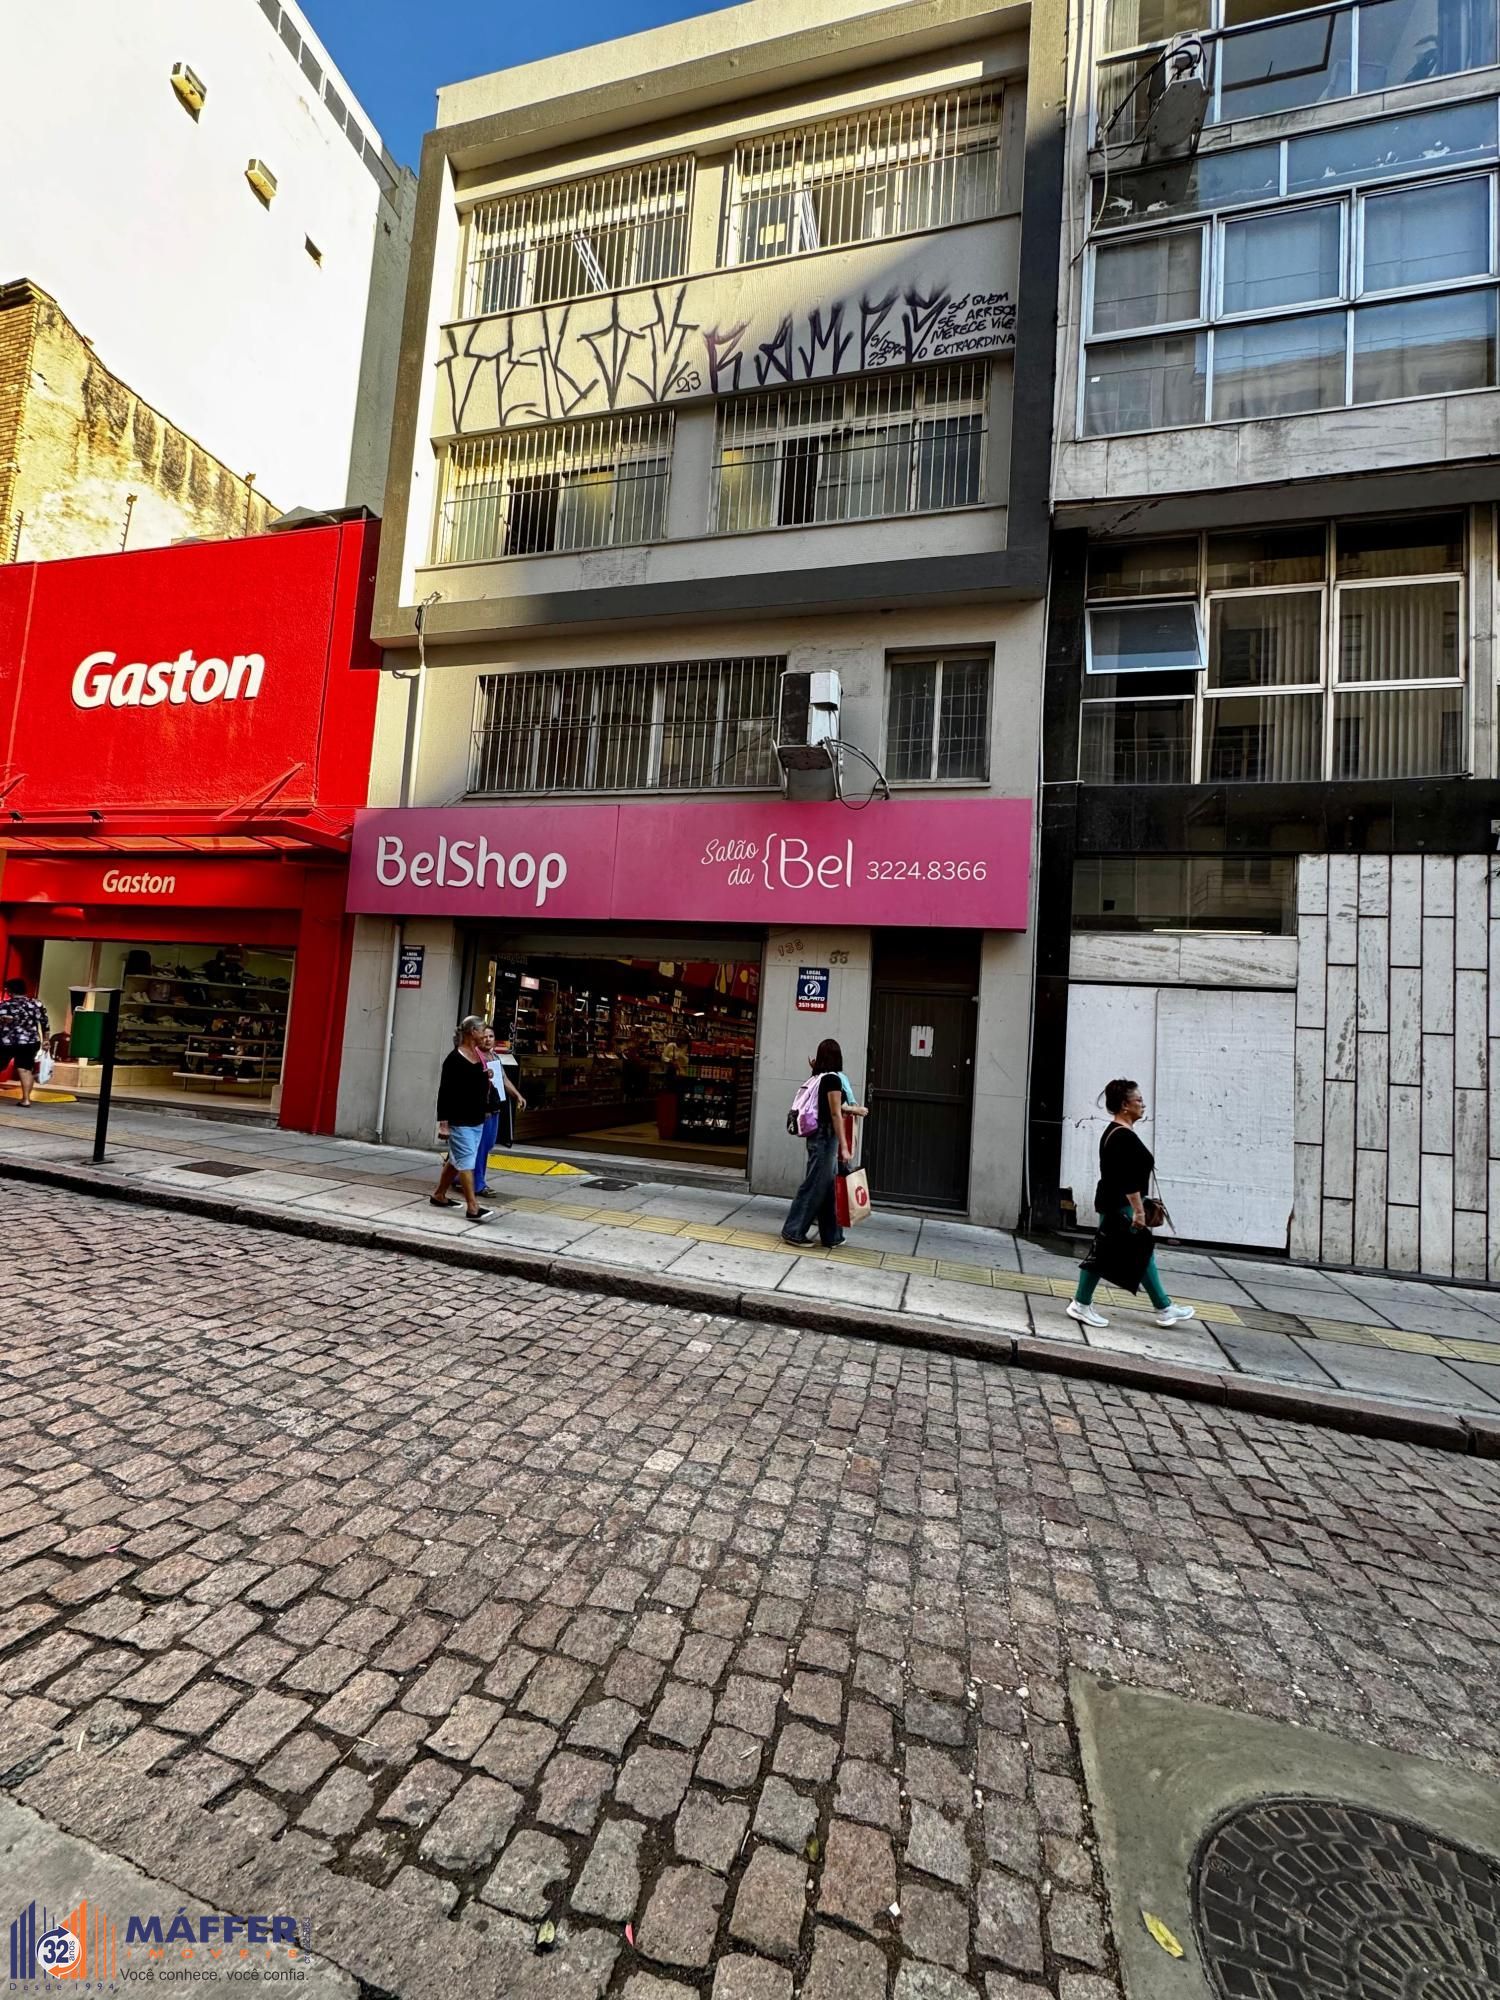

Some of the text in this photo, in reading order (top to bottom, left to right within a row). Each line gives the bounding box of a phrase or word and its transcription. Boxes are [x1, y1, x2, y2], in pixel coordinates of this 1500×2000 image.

[948, 292, 1008, 314] SÓ QUEM
[930, 321, 986, 344] MERECE
[937, 315, 956, 329] SE
[71, 649, 266, 710] Gaston
[701, 838, 760, 865] Salão
[102, 869, 176, 894] Gaston
[376, 835, 568, 907] BelShop
[727, 864, 755, 886] da
[866, 860, 988, 881] 3224.8366
